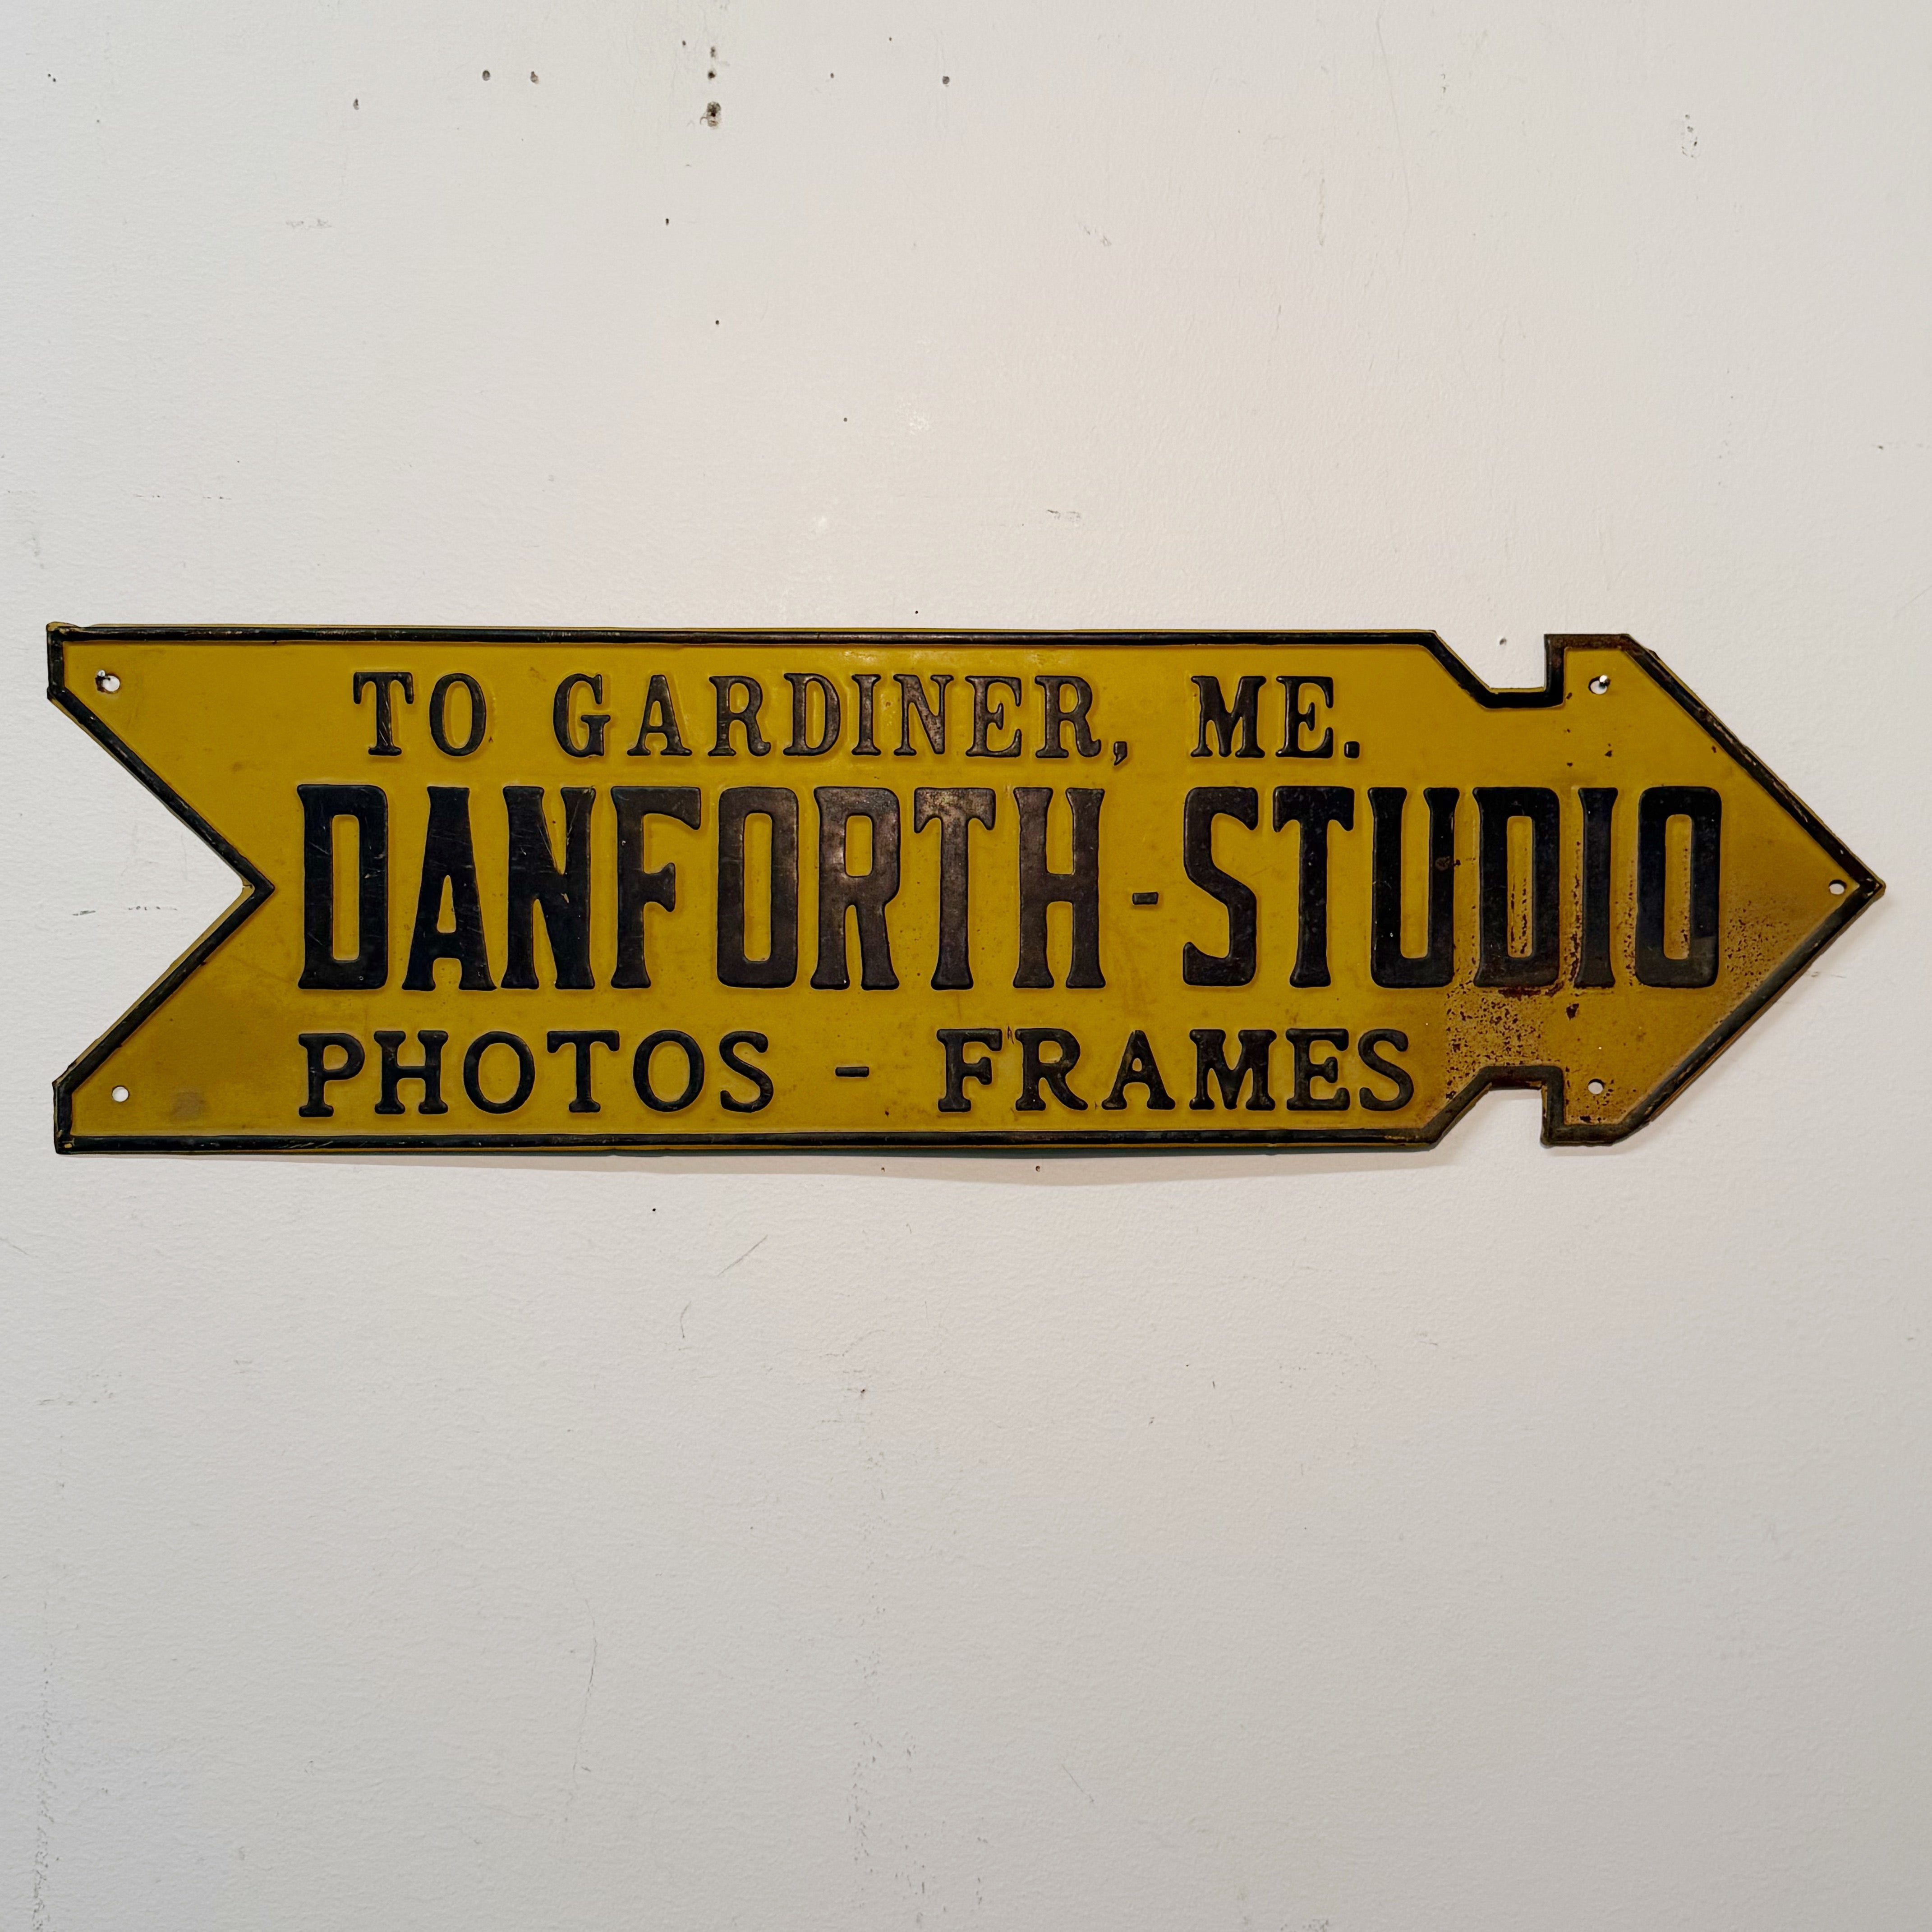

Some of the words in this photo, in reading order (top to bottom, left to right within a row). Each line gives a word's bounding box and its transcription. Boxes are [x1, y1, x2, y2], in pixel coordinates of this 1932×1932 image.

[353, 672, 486, 756] TO
[553, 673, 1127, 765] GARDINER,
[1191, 676, 1359, 759] ME.
[299, 1030, 773, 1118] PHOTOS
[937, 1028, 1414, 1113] FRAMES
